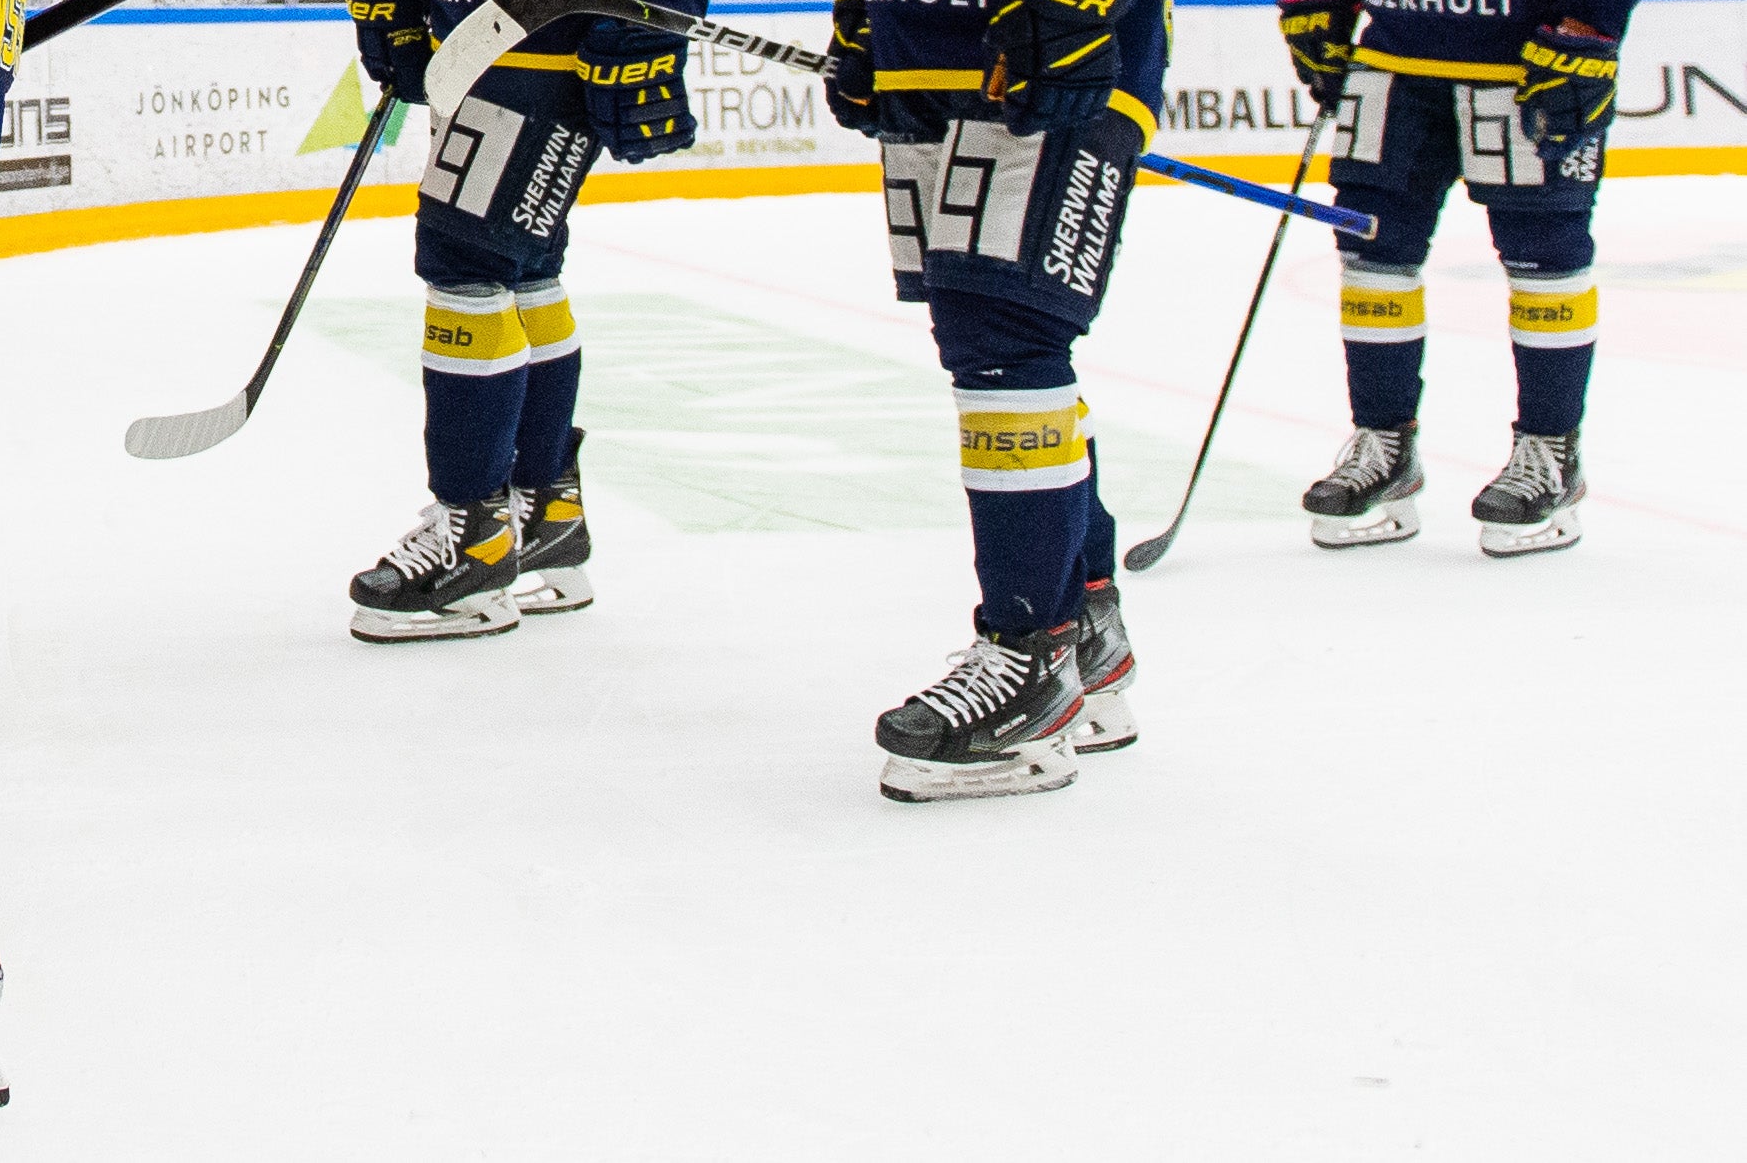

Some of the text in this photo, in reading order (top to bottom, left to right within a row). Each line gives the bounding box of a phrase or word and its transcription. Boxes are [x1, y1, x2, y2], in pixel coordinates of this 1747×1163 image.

[136, 82, 291, 116] JÖNKÖPING
[154, 129, 268, 159] AIRPORT
[511, 124, 571, 231] SHERWIN
[531, 132, 589, 239] WILLIAMS
[1044, 149, 1100, 285] SHERWIN
[1069, 161, 1122, 297] WILLIAMS
[425, 324, 473, 348] sab
